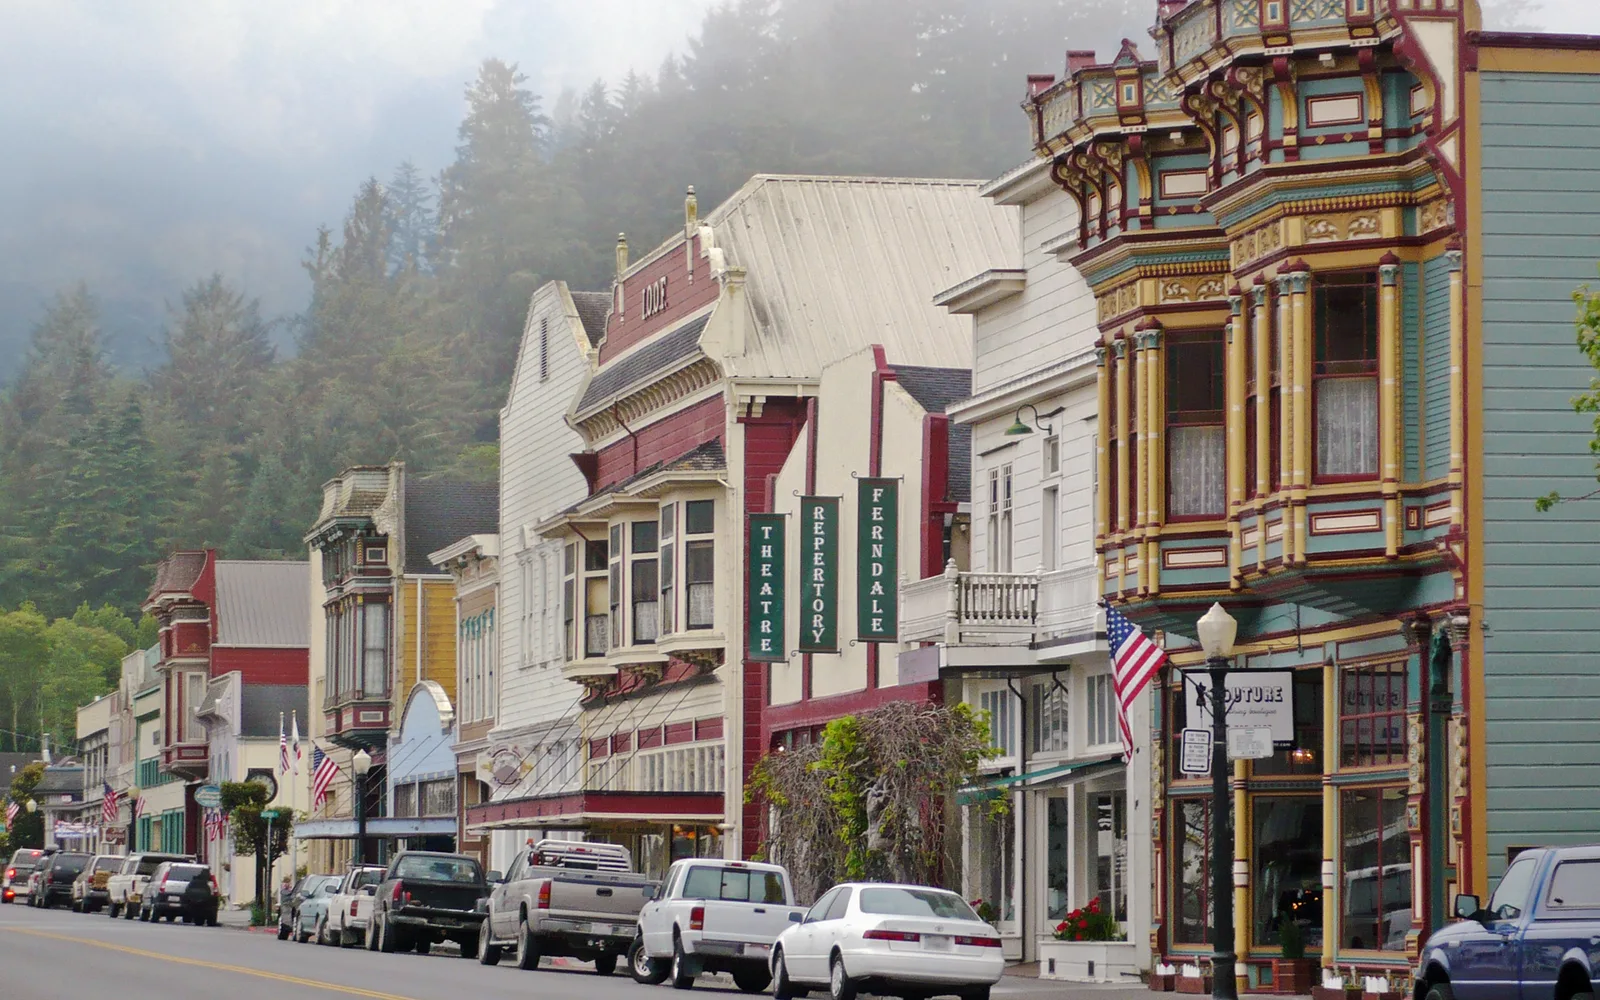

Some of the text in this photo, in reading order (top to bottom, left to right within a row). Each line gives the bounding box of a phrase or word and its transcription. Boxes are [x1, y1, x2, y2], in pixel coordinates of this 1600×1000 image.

[760, 526, 773, 651] THEATRE
[812, 506, 825, 643] REPERTORY
[870, 488, 884, 632] FERNDALE
[1224, 686, 1283, 702] OUTURE
